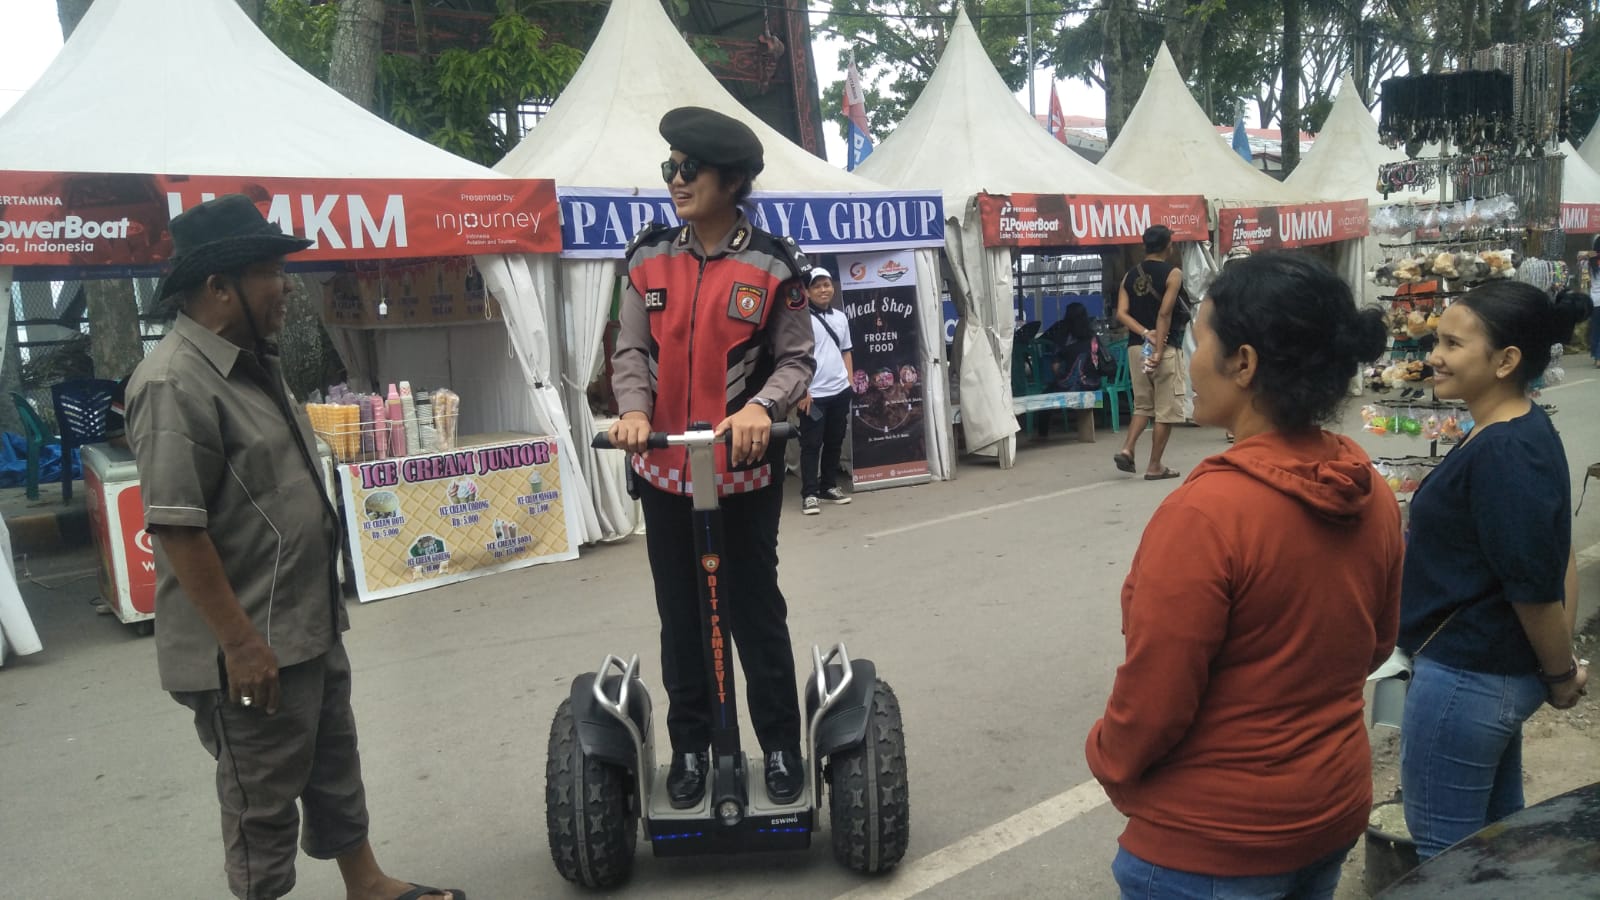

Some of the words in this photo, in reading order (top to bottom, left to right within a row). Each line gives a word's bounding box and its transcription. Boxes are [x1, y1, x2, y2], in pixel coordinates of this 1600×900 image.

[0, 196, 62, 206] RTAMINA
[828, 200, 936, 240] GROUP
[1000, 218, 1059, 231] F1PowerBoat
[1070, 204, 1151, 238] UMKM
[1279, 210, 1332, 242] UMKM
[24, 240, 94, 252] Indonesia
[846, 300, 875, 319] Meat
[882, 297, 912, 318] Shop
[865, 332, 898, 342] FROZEN
[870, 343, 894, 352] FOOD
[360, 462, 398, 489] ICE
[403, 451, 474, 482] CREAM
[478, 441, 550, 475] JUNIOR
[771, 817, 798, 825] ESWING
